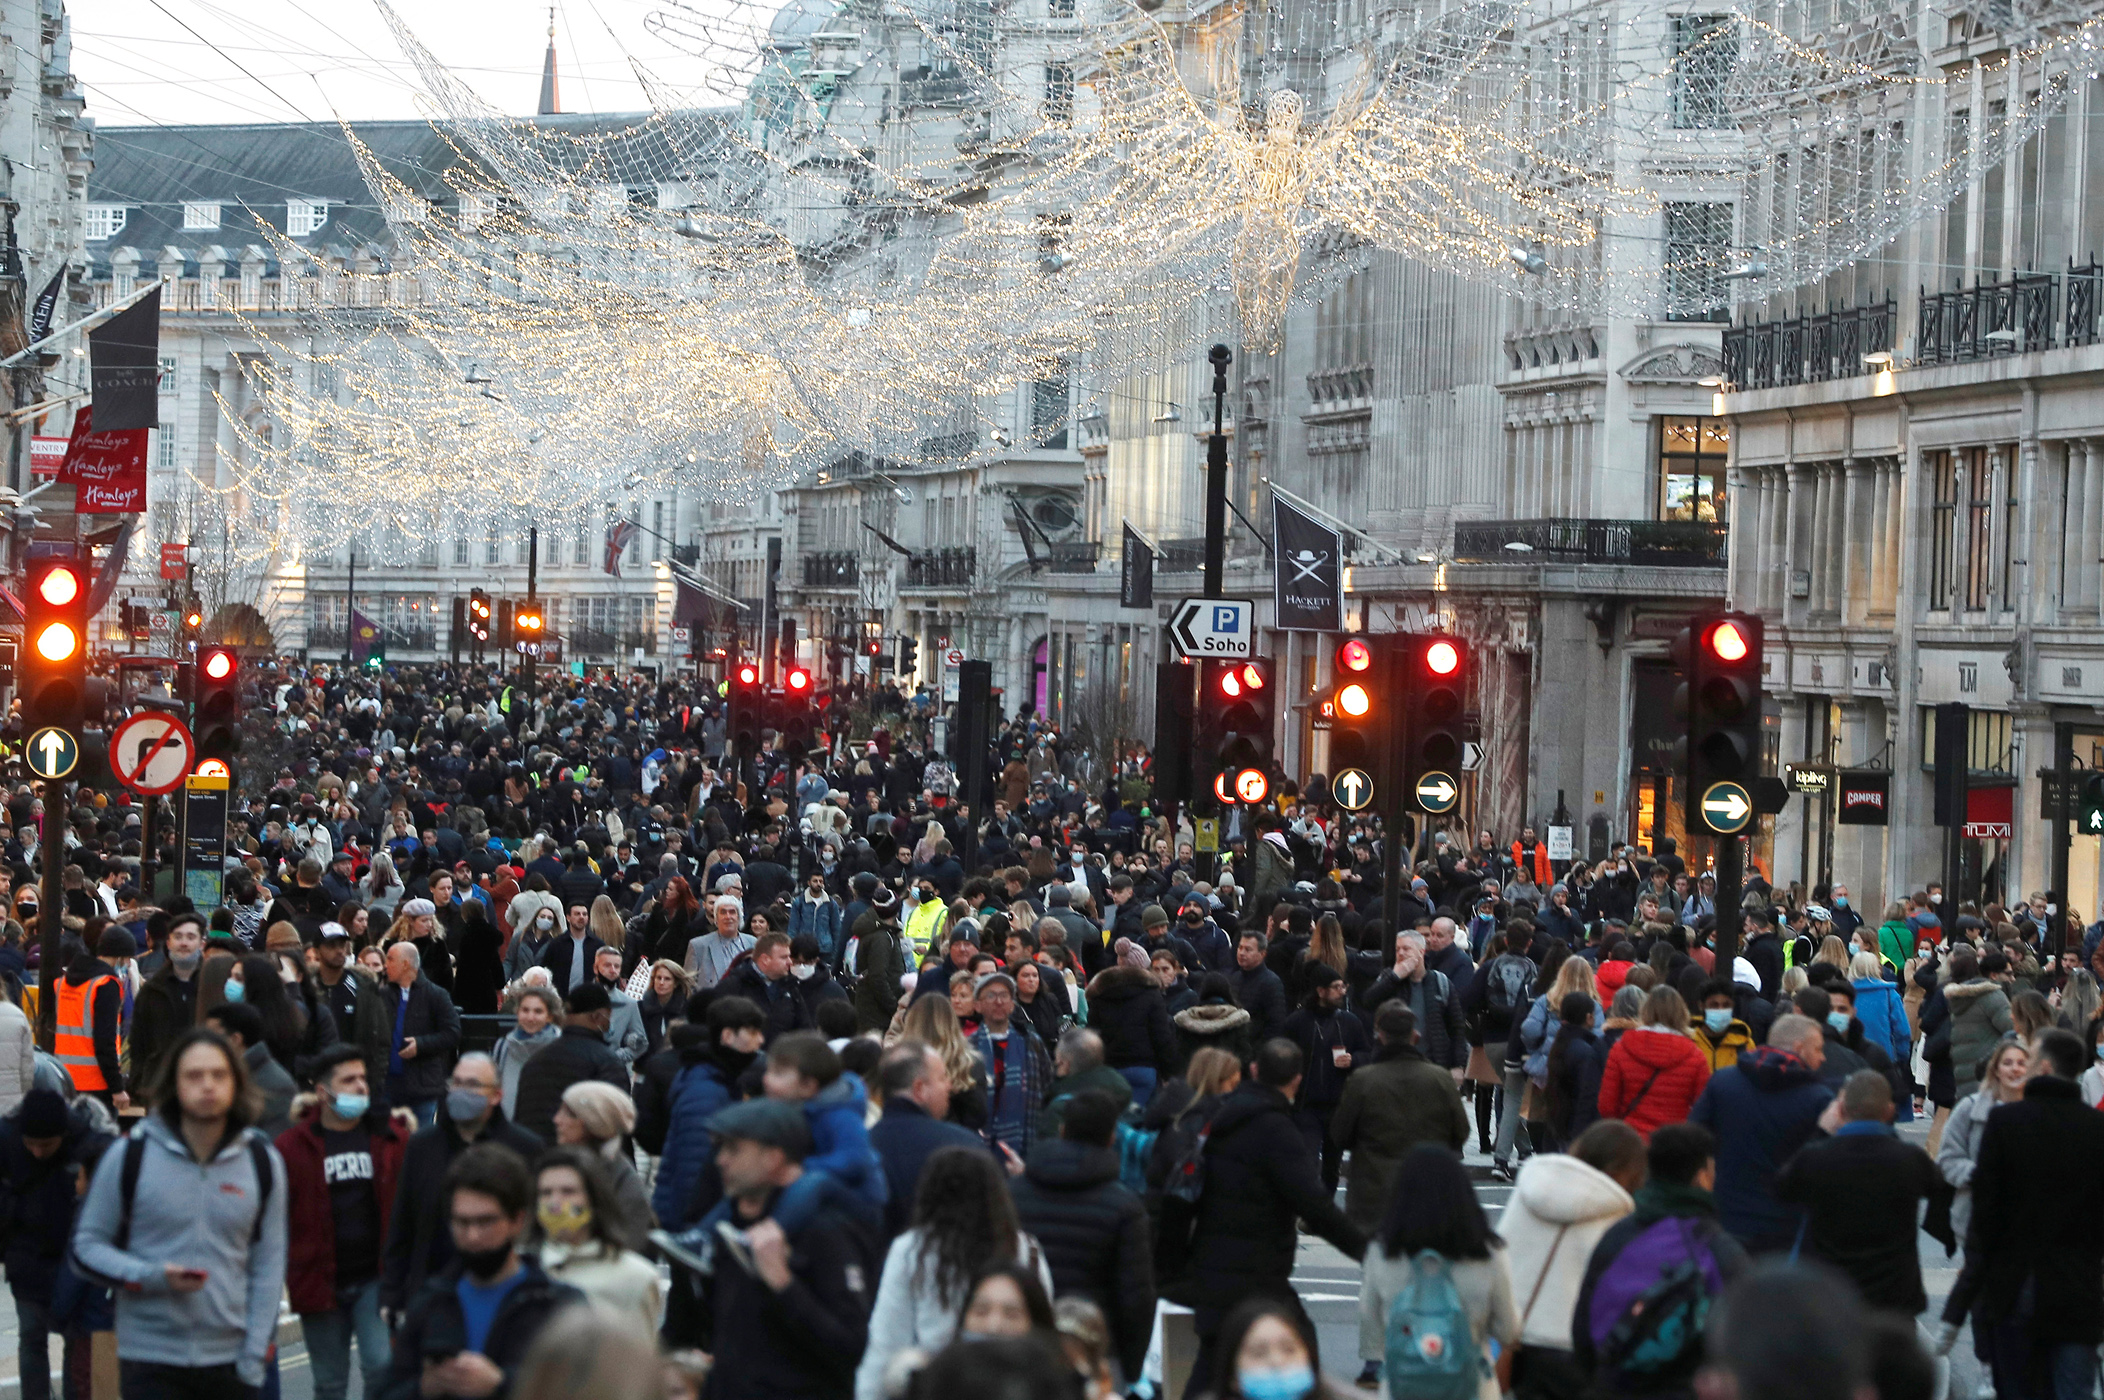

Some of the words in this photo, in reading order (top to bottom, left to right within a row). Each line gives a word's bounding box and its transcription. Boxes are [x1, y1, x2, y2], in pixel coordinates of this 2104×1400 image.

[65, 453, 122, 481] Hamleys
[83, 485, 138, 508] Hamleys
[1285, 595, 1331, 606] HACKETT
[1218, 608, 1235, 631] P
[1203, 637, 1247, 652] Soho
[1795, 770, 1827, 787] kipling
[1847, 791, 1882, 807] CAMPER
[1962, 822, 2011, 837] TUMI
